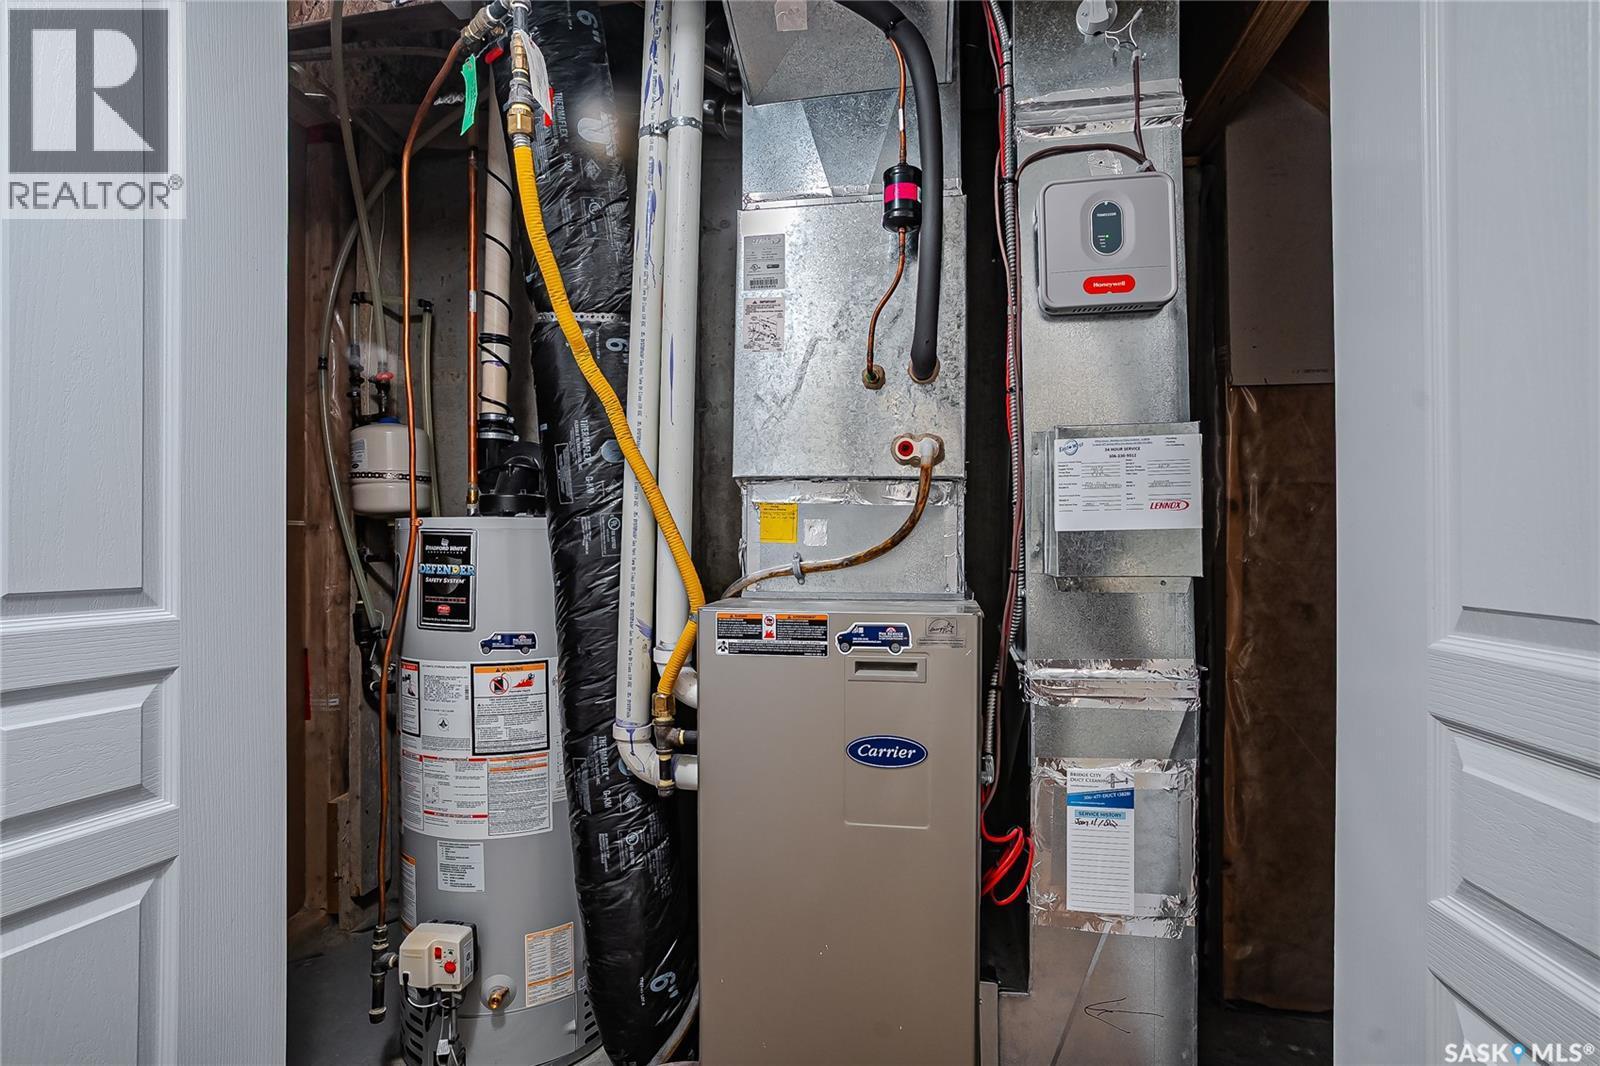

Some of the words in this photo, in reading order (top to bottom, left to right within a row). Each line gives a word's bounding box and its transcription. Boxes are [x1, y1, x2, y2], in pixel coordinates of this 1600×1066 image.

[1150, 501, 1182, 510] LENNOX
[418, 563, 476, 577] DEFENDER
[857, 744, 916, 758] Carrier
